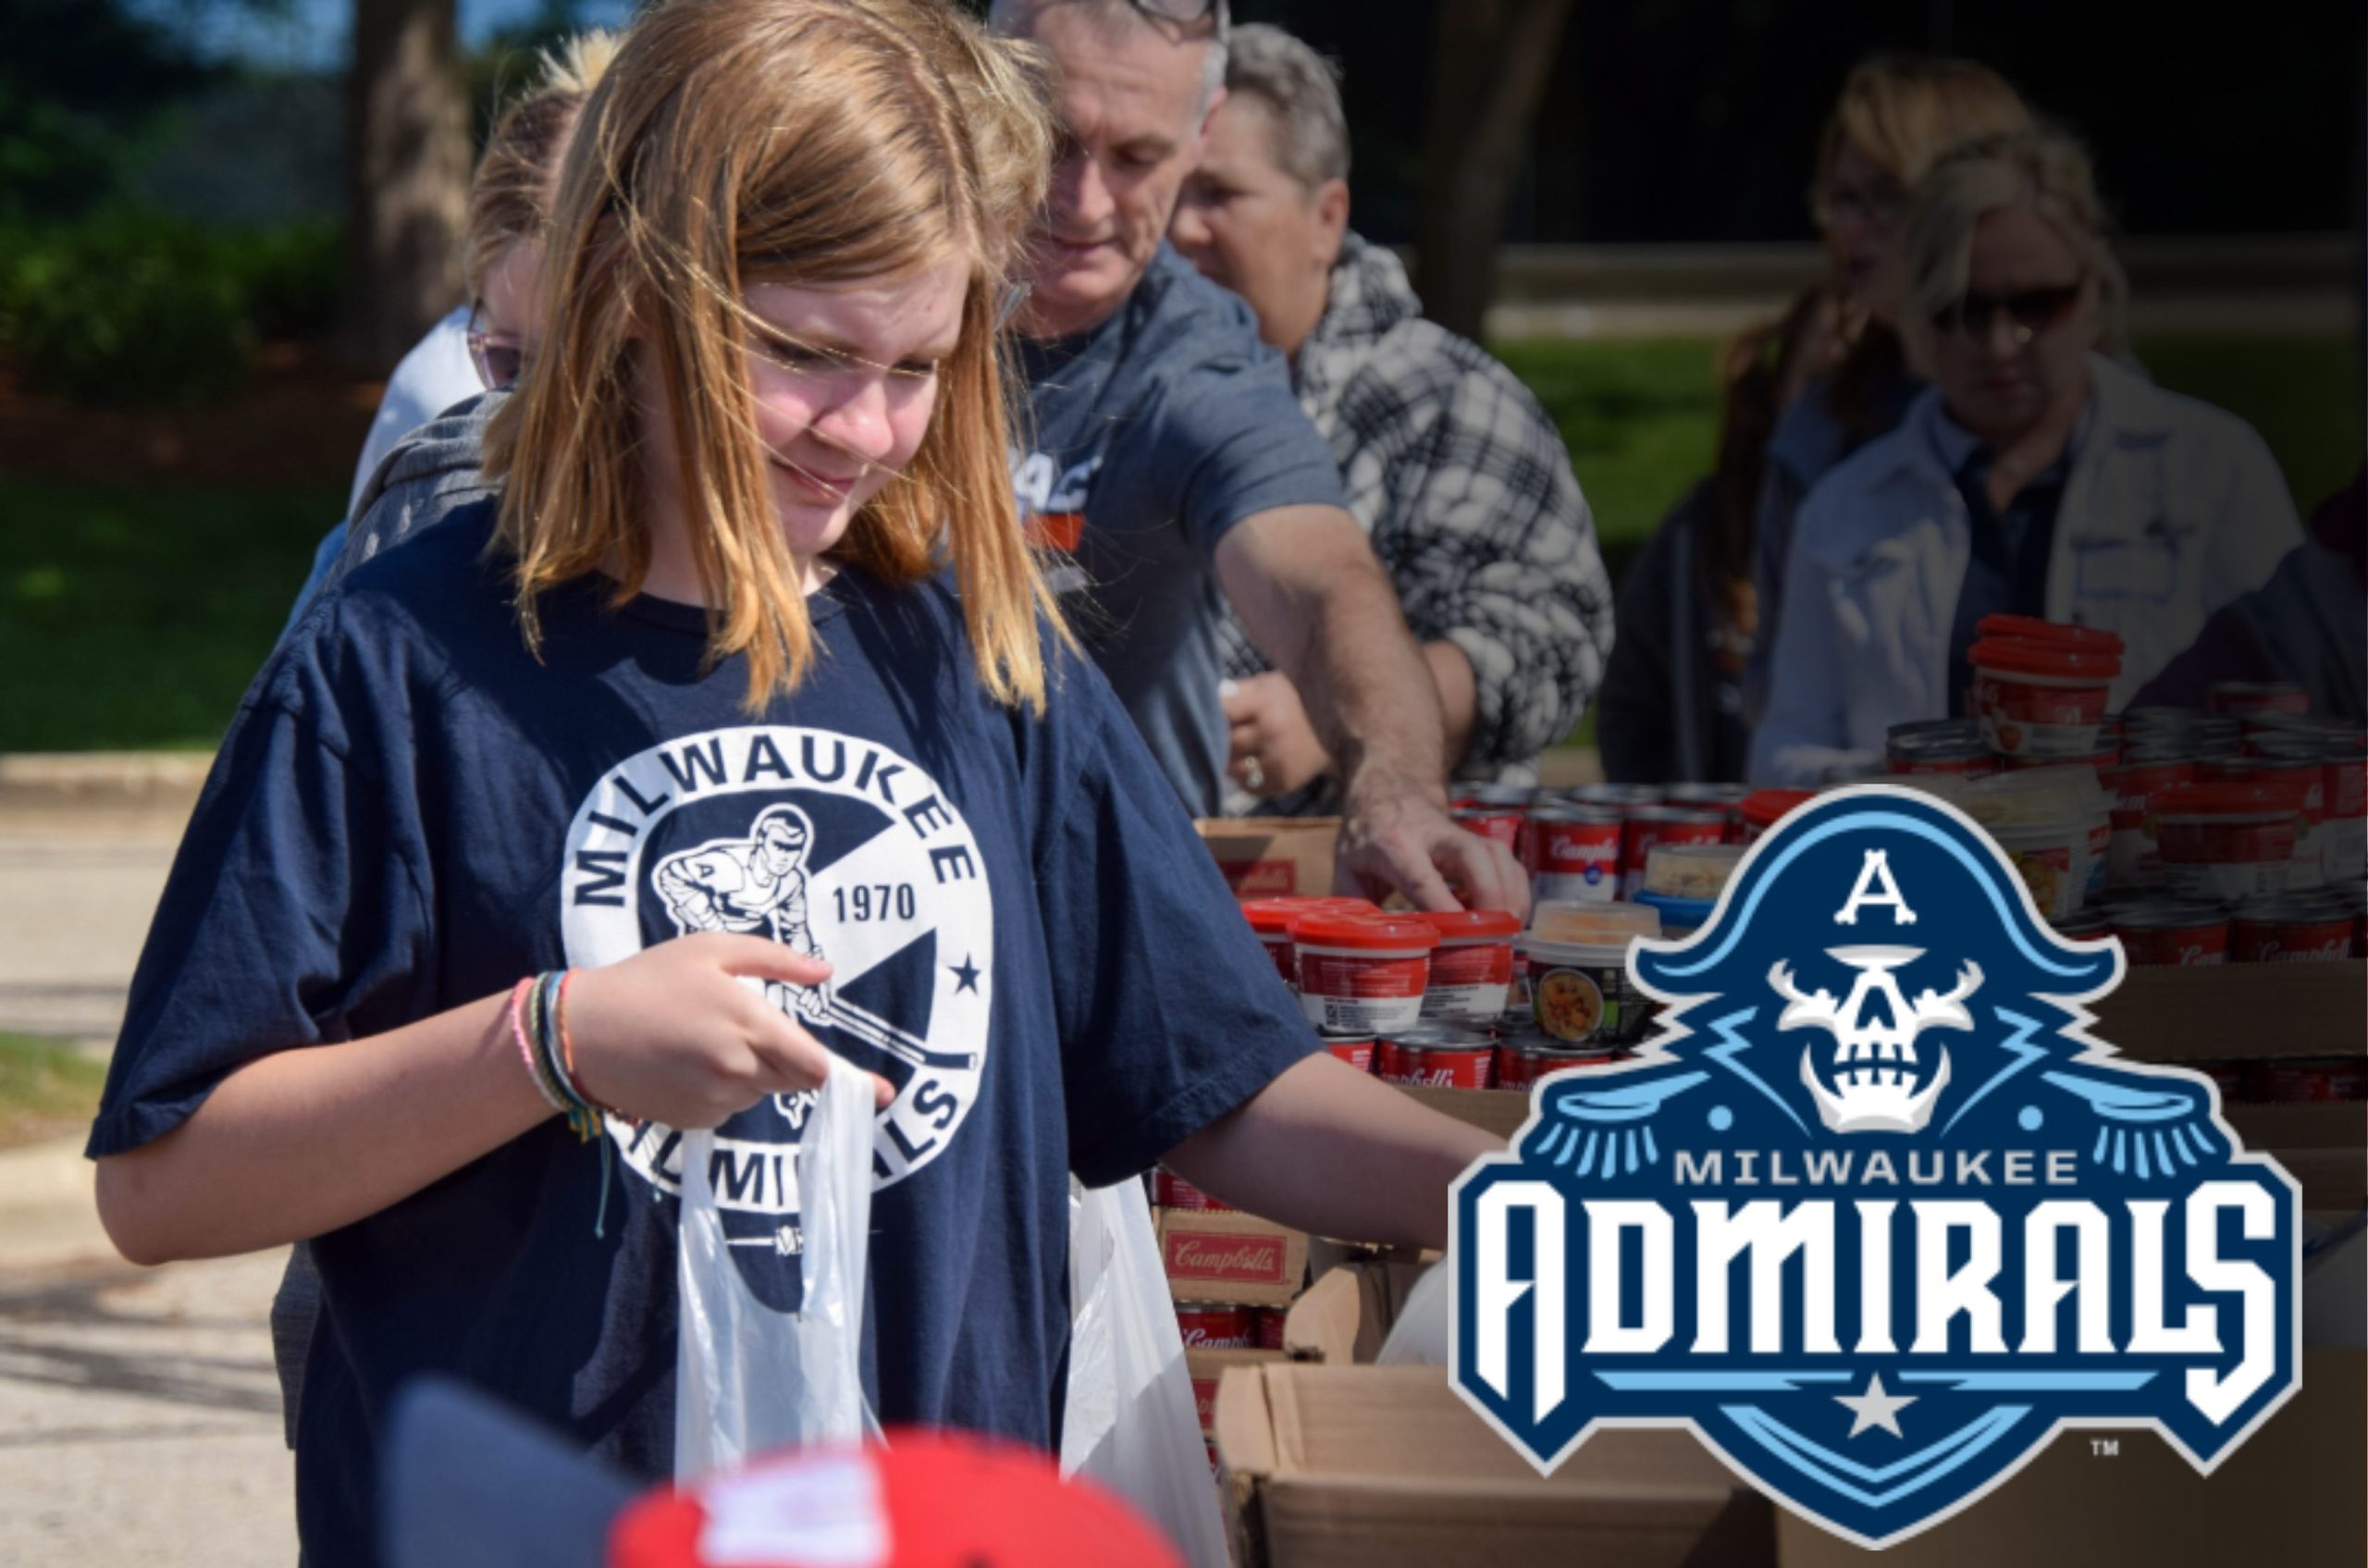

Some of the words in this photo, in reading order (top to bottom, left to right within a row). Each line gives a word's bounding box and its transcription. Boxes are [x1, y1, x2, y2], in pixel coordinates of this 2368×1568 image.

[574, 735, 976, 908] MILWAUKEE
[832, 883, 916, 923] 1970
[1175, 1240, 1275, 1275] Campbell's
